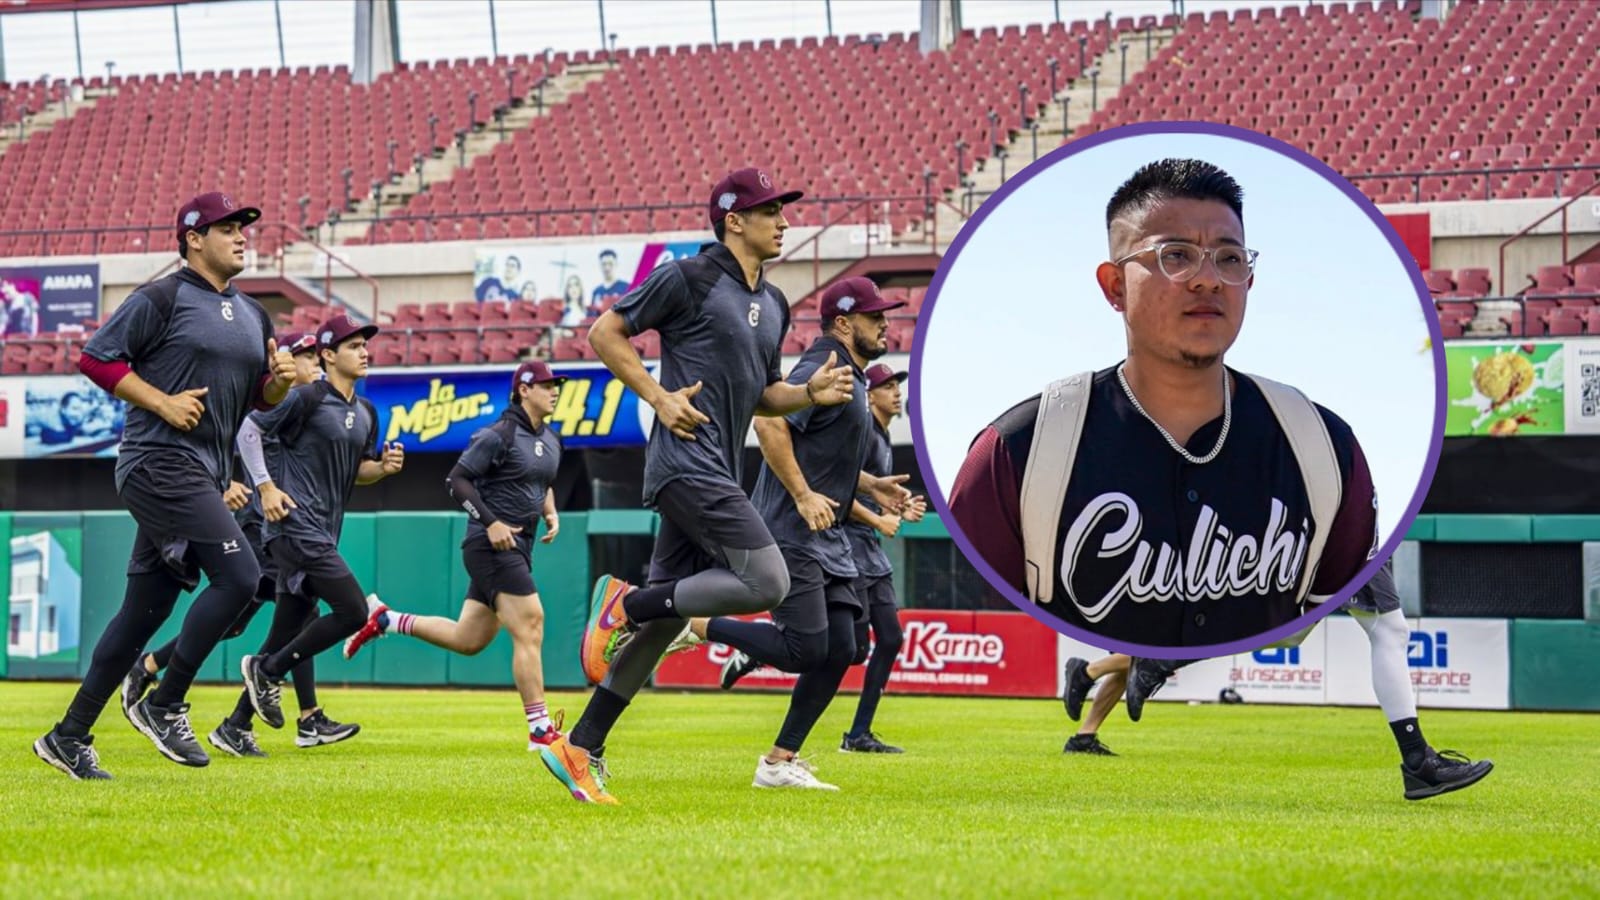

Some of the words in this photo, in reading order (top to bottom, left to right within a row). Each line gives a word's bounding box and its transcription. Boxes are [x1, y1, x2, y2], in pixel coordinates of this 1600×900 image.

[543, 378, 625, 437] 4.1
[866, 621, 1004, 669] Karne
[1247, 666, 1322, 683] instante
[1409, 670, 1471, 686] stante
